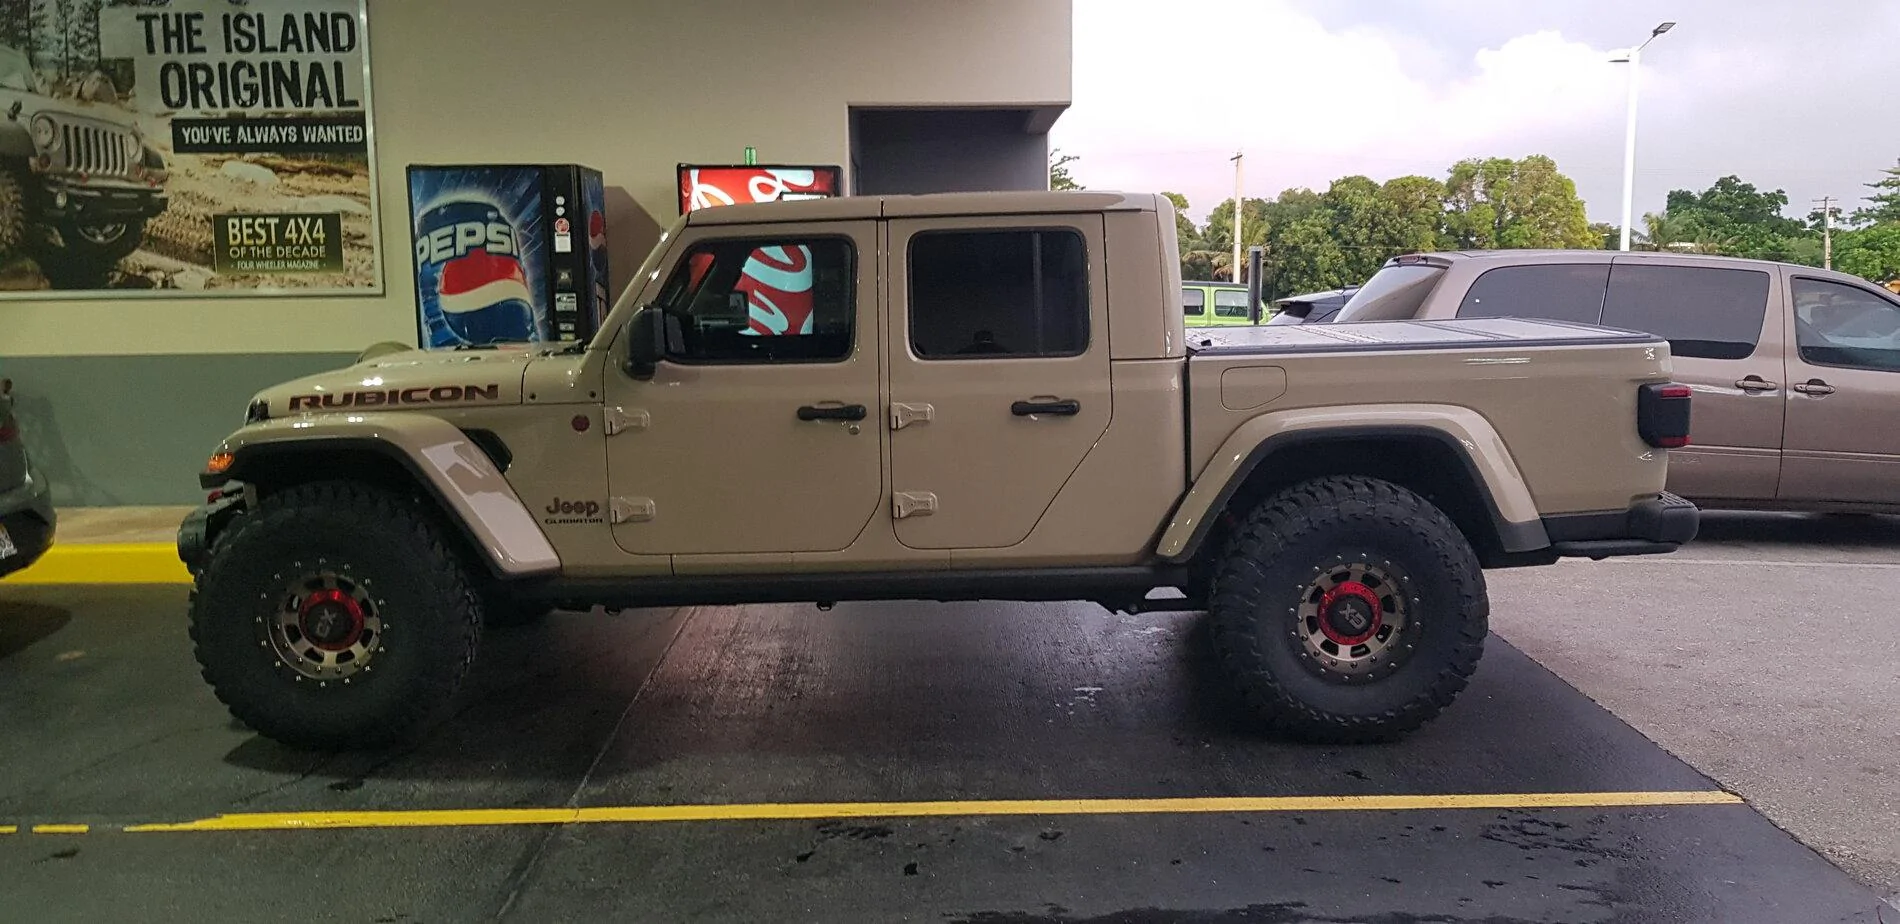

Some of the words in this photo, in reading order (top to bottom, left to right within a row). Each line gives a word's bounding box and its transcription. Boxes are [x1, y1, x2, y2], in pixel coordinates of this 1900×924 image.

[136, 12, 207, 54] THE
[222, 12, 356, 54] ISLAND
[160, 59, 359, 108] ORIGINAL
[182, 126, 232, 144] YOU'VE
[237, 125, 297, 144] ALWAYS
[303, 125, 363, 143] WANTED
[227, 217, 279, 246] BEST
[284, 217, 326, 245] 4X4
[229, 246, 247, 258] OF
[249, 246, 273, 258] THE
[276, 245, 326, 258] DECADE
[416, 221, 519, 275] PEPSI
[237, 261, 255, 270] FOUR
[256, 261, 286, 270] WHEELER
[287, 260, 319, 270] MAGAZINE
[289, 384, 499, 411] RUBICON
[546, 496, 599, 518] Jeep
